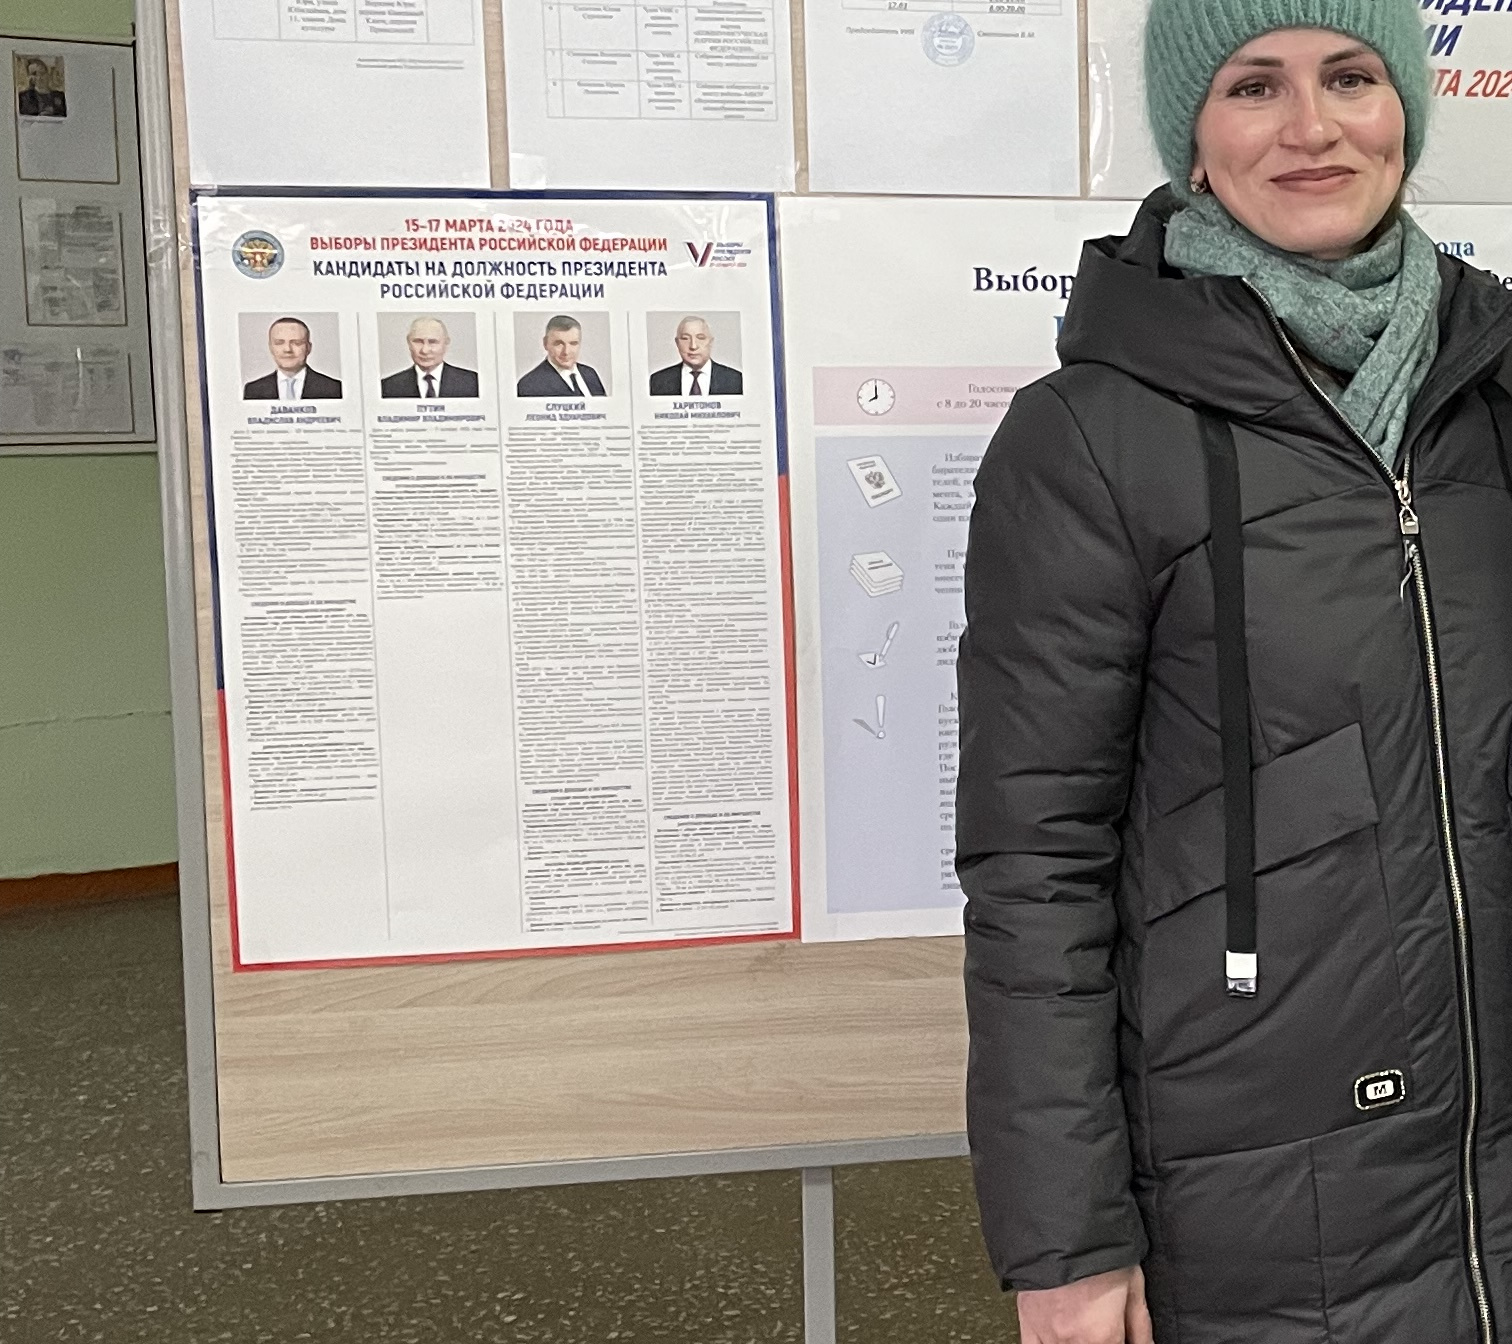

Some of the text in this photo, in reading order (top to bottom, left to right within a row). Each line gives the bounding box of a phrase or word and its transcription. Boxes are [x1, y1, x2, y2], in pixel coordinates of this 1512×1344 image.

[445, 219, 494, 233] МАРТА
[310, 234, 668, 253] ВЫБОРЫ ПРЕЗИДЕНТА РОССИЙСКОЙ ФЕДЕРАЦИИ
[313, 260, 668, 278] КАНДИДАТЫ НА ДОЛЖНОСТЬ ПРЕЗИДЕНТА
[380, 280, 605, 301] РОССИЙСКОЙ ФЕДЕРАЦИИ
[973, 266, 1076, 300] Выбор
[545, 402, 586, 412] СЛУЦКИЙ
[945, 399, 951, 408] 8
[953, 401, 968, 409] до
[969, 399, 981, 408] 20
